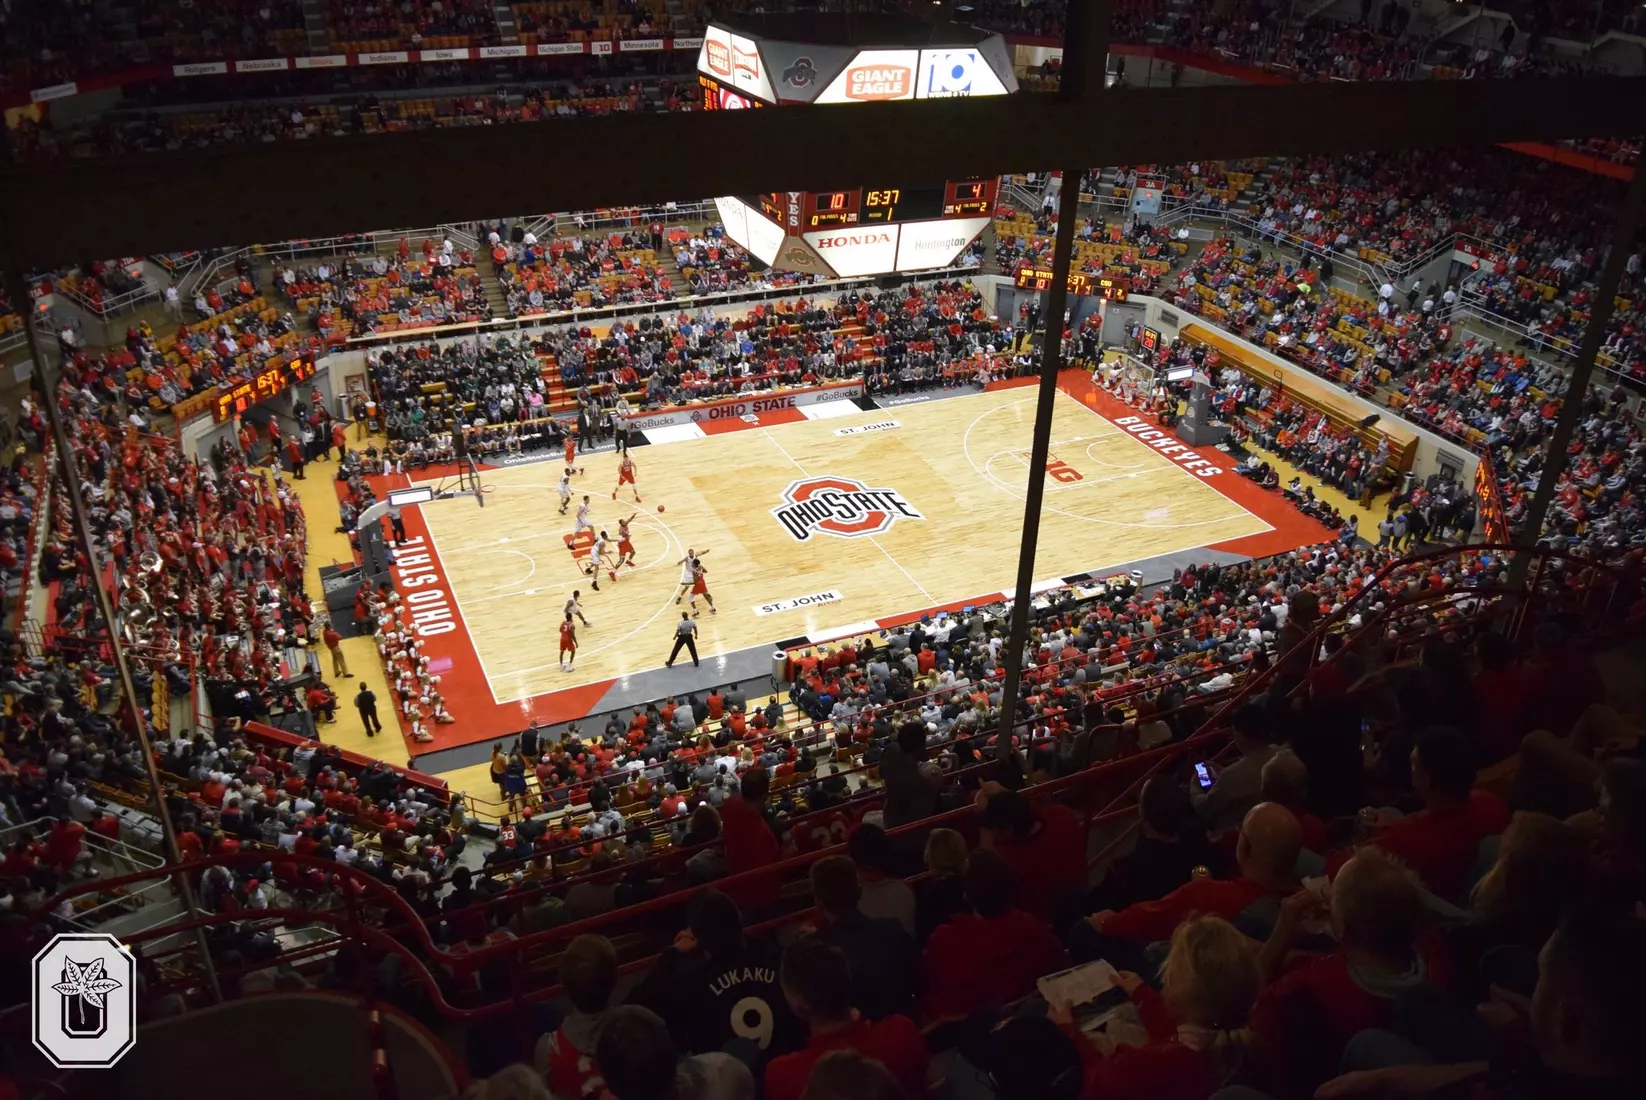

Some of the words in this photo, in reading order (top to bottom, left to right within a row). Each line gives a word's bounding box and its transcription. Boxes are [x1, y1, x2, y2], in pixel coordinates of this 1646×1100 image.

[624, 40, 659, 48] Minnesota
[369, 54, 397, 62] Indiana
[852, 70, 905, 82] GIANT
[852, 81, 902, 95] EAGLE
[866, 190, 899, 206] 15:37
[972, 184, 980, 198] 4
[830, 194, 844, 209] 10
[980, 202, 987, 212] 2
[811, 215, 818, 226] 0
[840, 213, 846, 223] 4
[887, 207, 892, 221] 1
[817, 233, 890, 248] HONDA
[914, 237, 966, 250] Huntington
[815, 388, 858, 402] #GoBucks
[708, 404, 746, 419] OHIO
[753, 396, 796, 413] STATE
[628, 416, 674, 430] #GoBucks
[863, 422, 895, 431] JOHN
[1114, 416, 1223, 476] BUCKEYES
[389, 536, 439, 588] STATE
[762, 604, 787, 613] ST.
[792, 592, 834, 607] JOHN
[407, 589, 456, 636] OHIO
[502, 831, 514, 840] 33
[709, 967, 775, 996] LUKAKU
[730, 996, 774, 1050] 9
